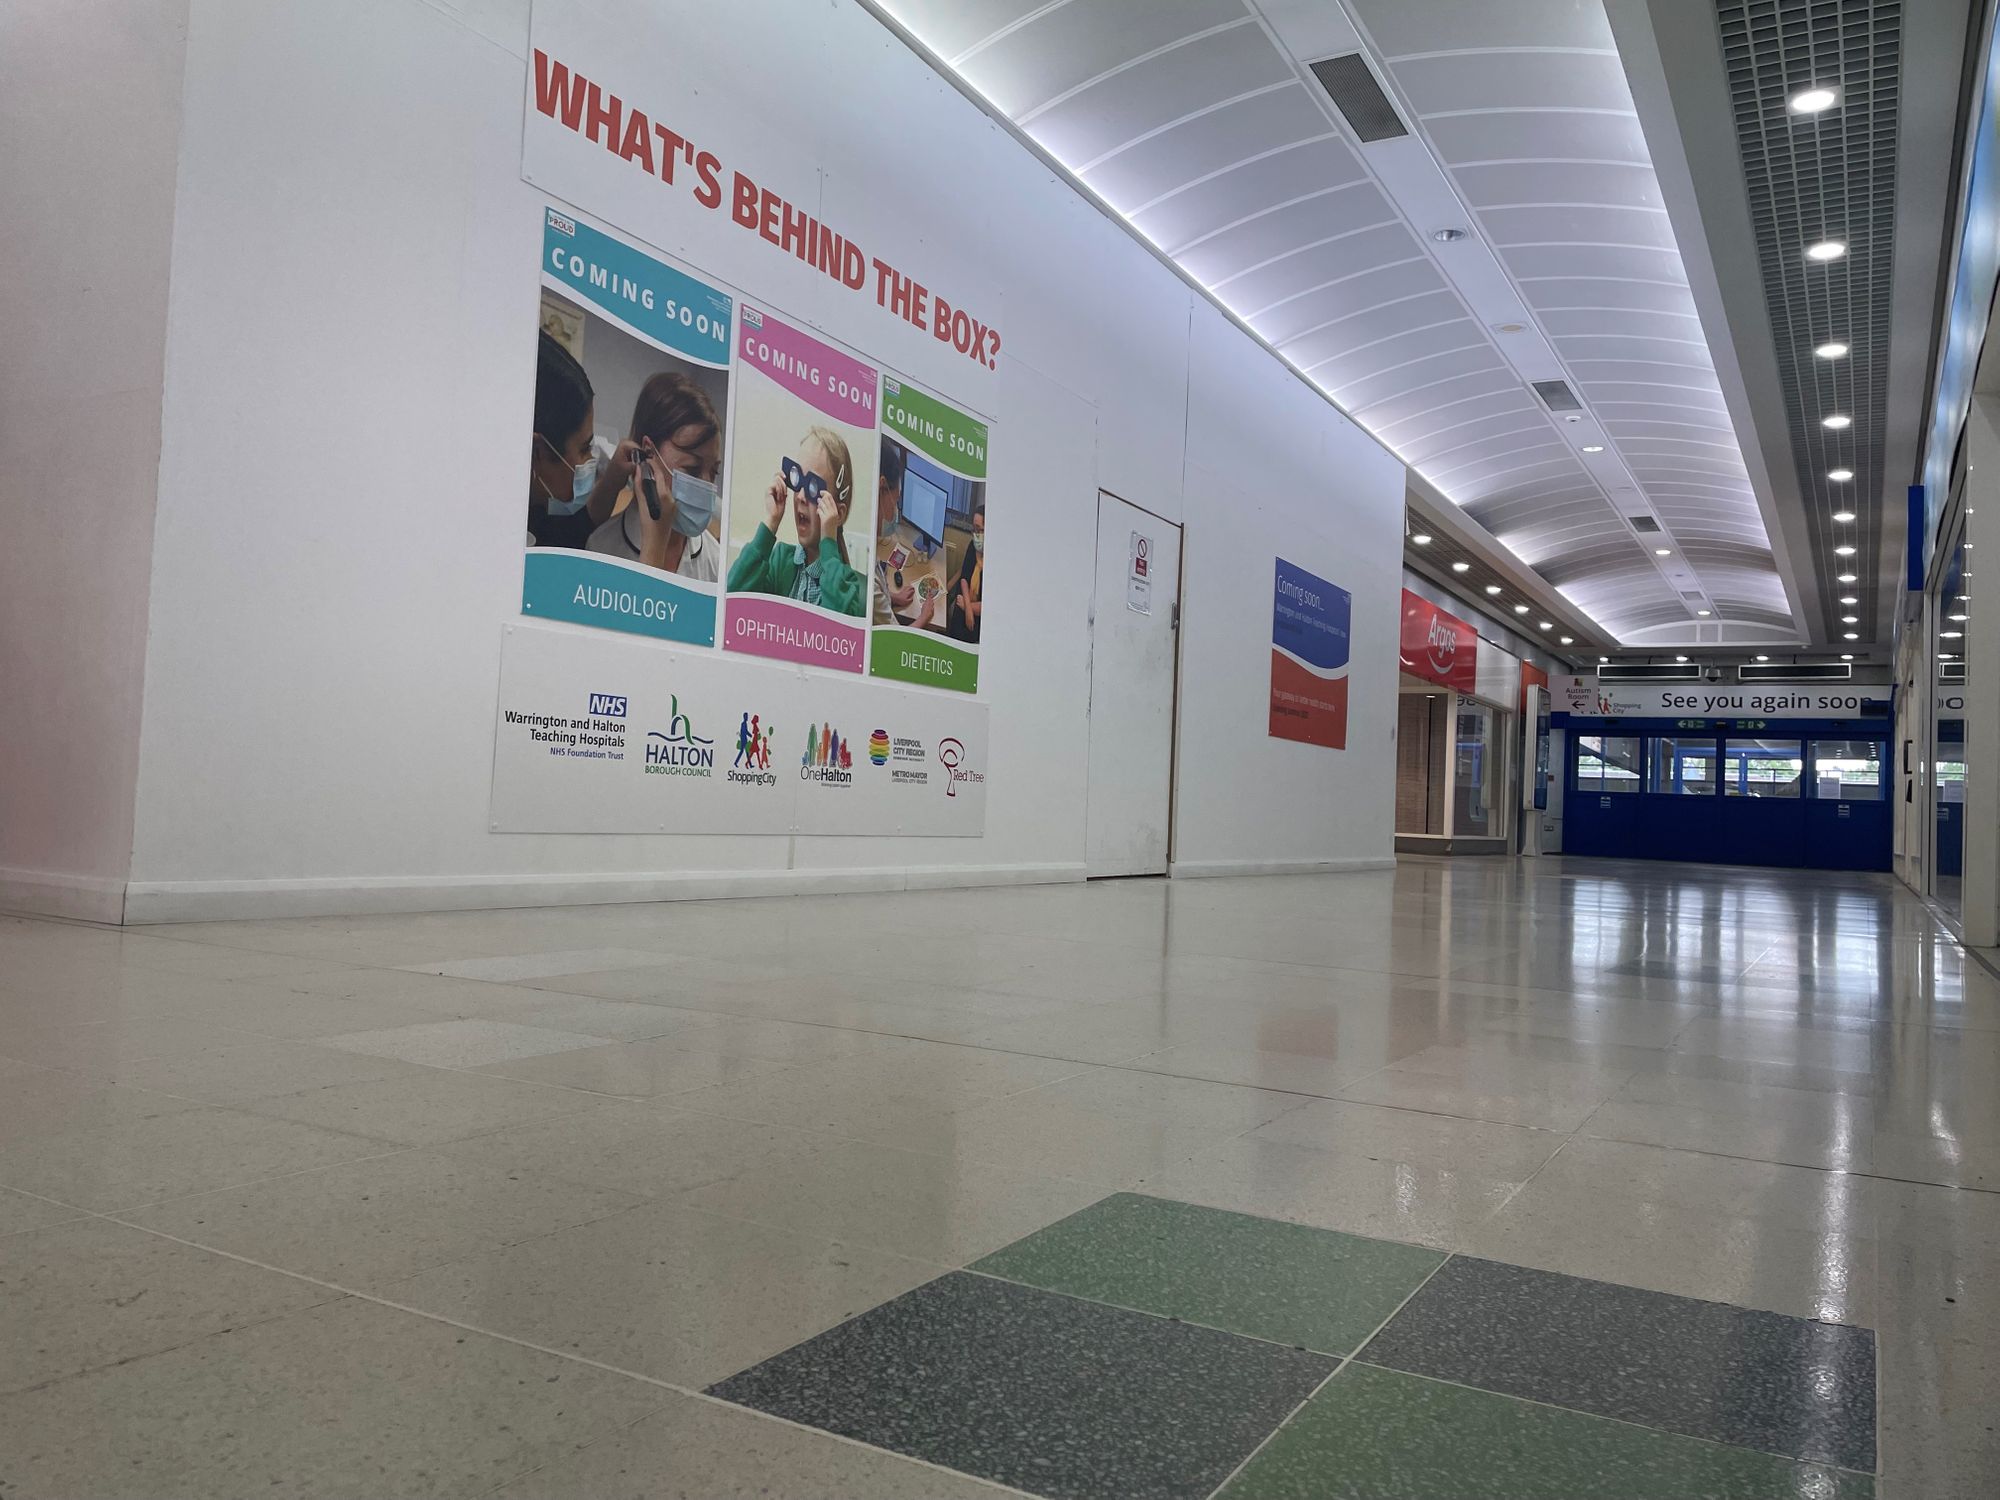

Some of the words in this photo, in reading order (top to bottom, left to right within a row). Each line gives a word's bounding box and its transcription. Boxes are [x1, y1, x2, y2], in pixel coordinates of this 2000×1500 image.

[534, 48, 722, 209] WHAT'S
[732, 171, 866, 291] BEHIND
[873, 257, 927, 331] THE
[934, 295, 1002, 371] BOX?
[549, 216, 574, 233] PROUD
[552, 248, 654, 310] COMING
[666, 299, 725, 343] SOON
[745, 337, 820, 386] COMING
[828, 375, 872, 410] SOON
[887, 404, 943, 443] COMING
[949, 433, 984, 461] SOON
[1277, 575, 1304, 607] Coming
[573, 584, 678, 623] AUDIOLOGY
[736, 617, 857, 657] OPHTHALMOLOGY
[1427, 613, 1456, 659] Argos
[900, 651, 953, 676] DIETETICS
[590, 695, 626, 715] NHS
[1612, 707, 1625, 715] City
[1613, 702, 1642, 710] Shopping
[1661, 692, 1698, 708] See
[1703, 695, 1743, 713] you
[1751, 693, 1810, 713] again
[505, 710, 567, 729] Warrington
[570, 718, 590, 730] and
[593, 719, 626, 733] Halton
[530, 728, 576, 746] Teaching
[579, 733, 625, 748] Hospitals
[893, 738, 922, 748] LIVERPOOL
[550, 747, 565, 756] NHS
[567, 748, 606, 759] Foundation
[608, 751, 624, 760] Trust
[645, 744, 713, 767] HALTON
[893, 747, 906, 756] CITY
[906, 748, 925, 758] REGION
[645, 765, 680, 776] BOROUGH
[682, 767, 712, 777] COUNCIL
[800, 765, 852, 783] OneHalton
[953, 768, 967, 782] Red
[968, 770, 985, 783] Tree
